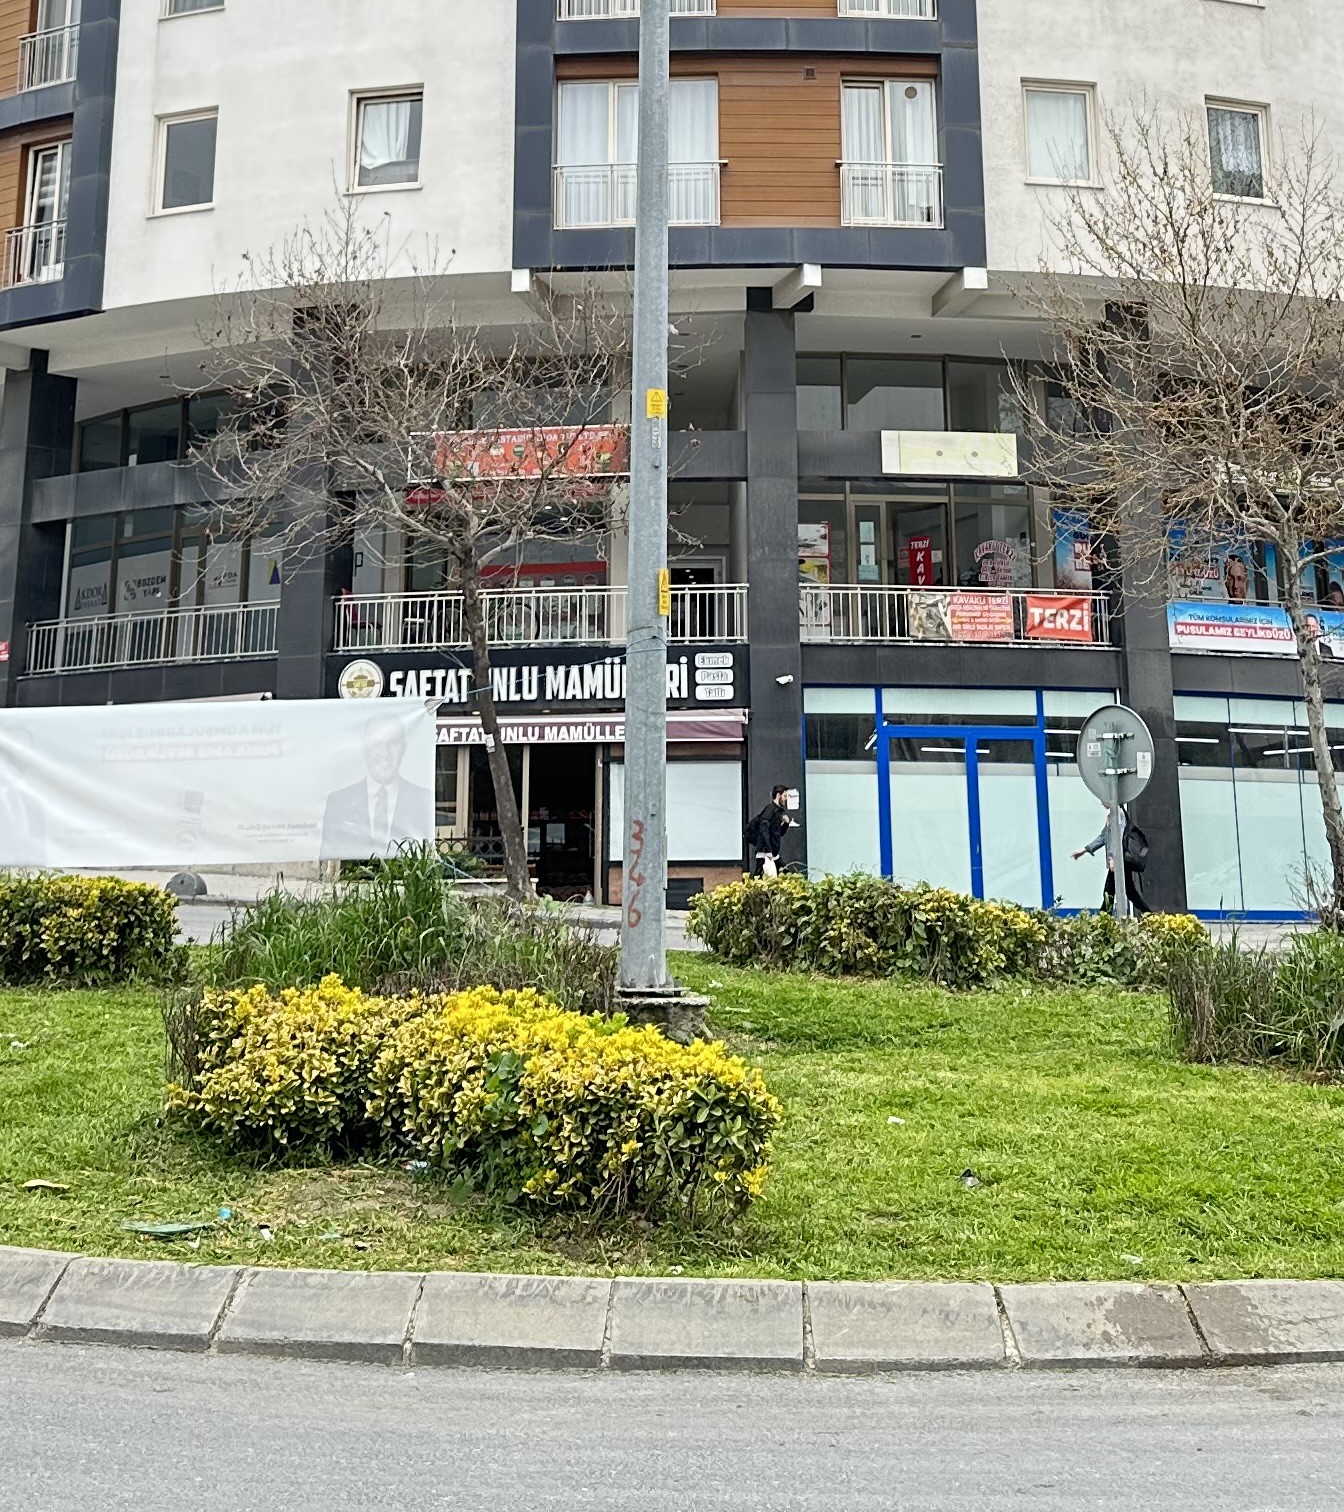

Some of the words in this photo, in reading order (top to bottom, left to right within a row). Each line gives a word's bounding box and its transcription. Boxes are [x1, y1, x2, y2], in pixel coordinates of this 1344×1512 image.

[1029, 602, 1089, 631] TERZİ
[1176, 624, 1232, 636] PUSULAMIZ
[546, 655, 688, 700] MAMÜRİ
